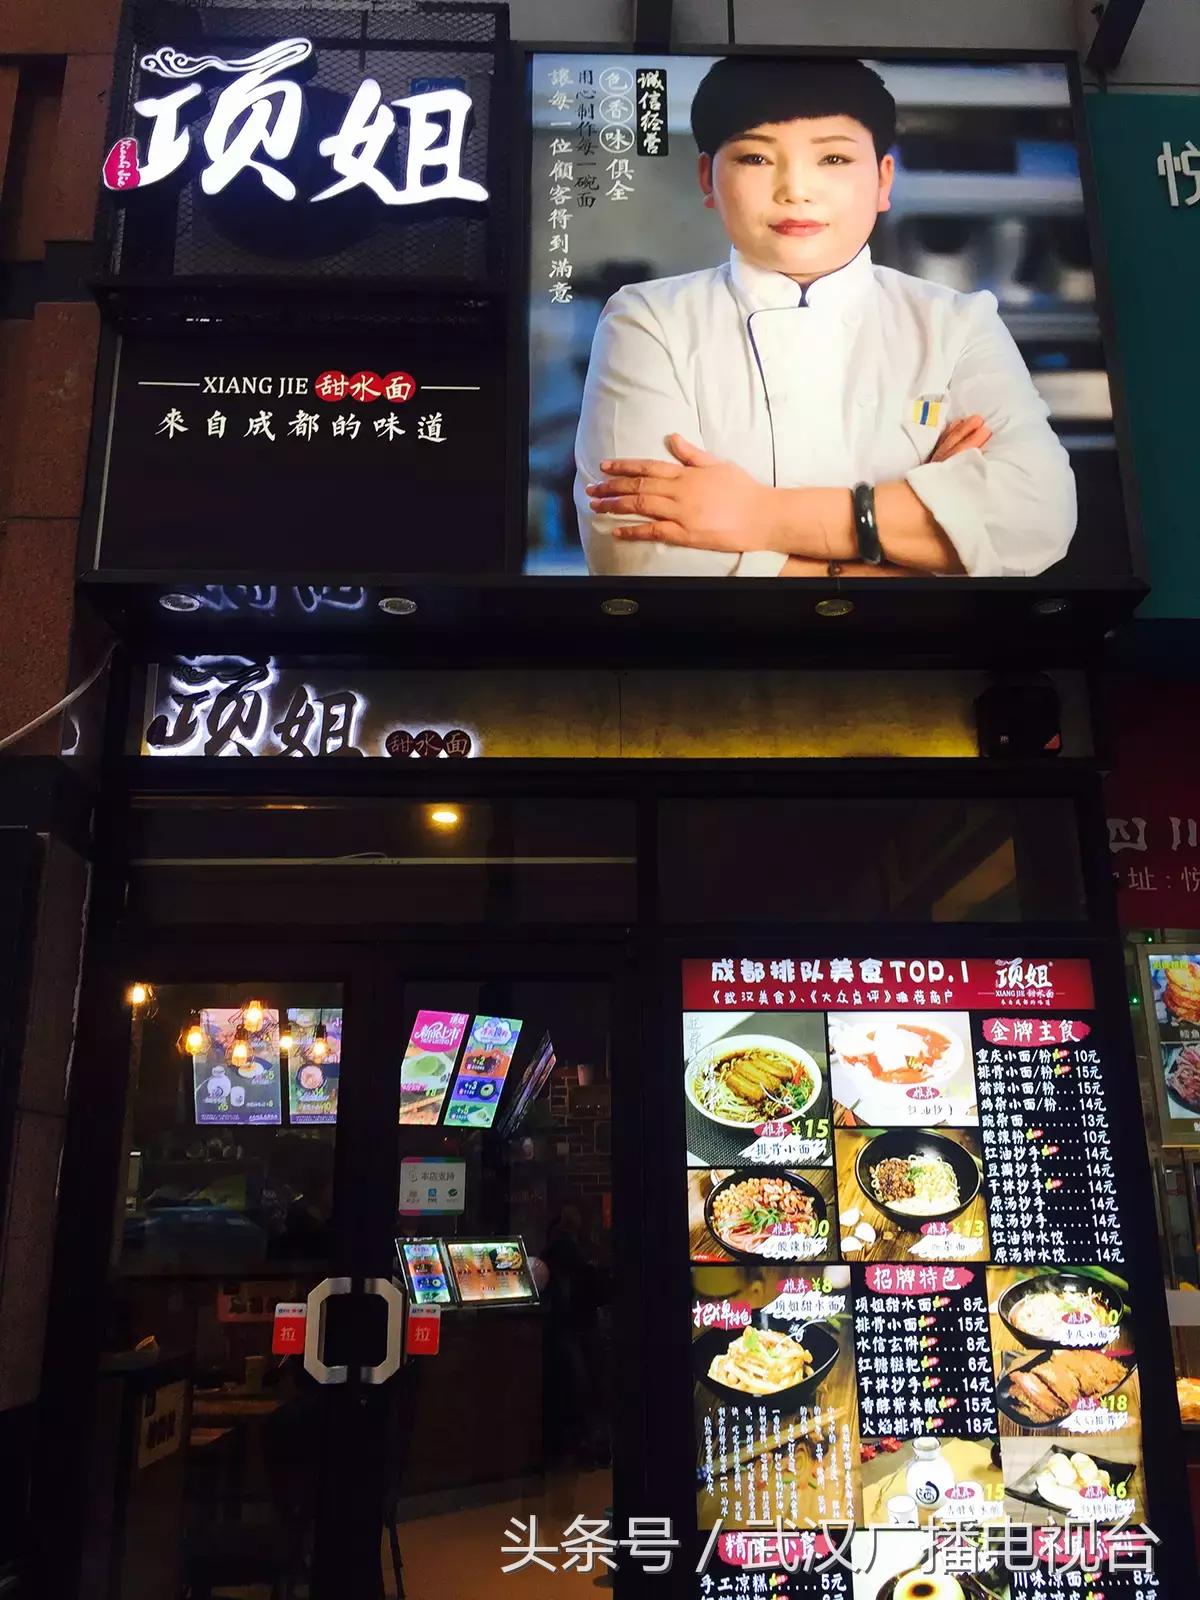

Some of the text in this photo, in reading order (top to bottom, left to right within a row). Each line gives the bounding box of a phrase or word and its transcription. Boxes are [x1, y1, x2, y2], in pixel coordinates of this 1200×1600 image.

[601, 70, 635, 201] 色香味俱全
[203, 373, 413, 401] XIANG JIE 甜水面
[155, 407, 447, 443] 來自成都的味道
[389, 732, 470, 757] 甜水面
[990, 1019, 1081, 1043] 金牌主食
[1074, 1050, 1101, 1064] 10元
[1076, 1066, 1103, 1080] 15元
[1078, 1082, 1105, 1096] 15元
[1079, 1098, 1107, 1112] 14元
[1081, 1114, 1109, 1128] 13元
[1083, 1130, 1111, 1144] 10元
[1085, 1147, 1113, 1161] 14元
[1087, 1163, 1115, 1178] 14元
[1088, 1180, 1117, 1194] 14元
[1090, 1197, 1119, 1212] 14元
[1092, 1214, 1121, 1228] 14元
[1094, 1231, 1123, 1246] 14元
[1096, 1248, 1125, 1263] 14元
[873, 1267, 961, 1291] 招牌特色
[963, 1297, 987, 1313] 8元
[958, 1316, 989, 1333] 15元
[280, 1326, 296, 1342] 拉
[415, 1326, 431, 1342] 拉
[966, 1337, 990, 1353] 8元
[968, 1356, 992, 1373] 6元
[962, 1377, 994, 1393] 14元
[964, 1397, 996, 1414] 15元
[966, 1418, 997, 1434] 18元
[821, 1573, 848, 1591] 5元
[1134, 1568, 1160, 1586] 8元
